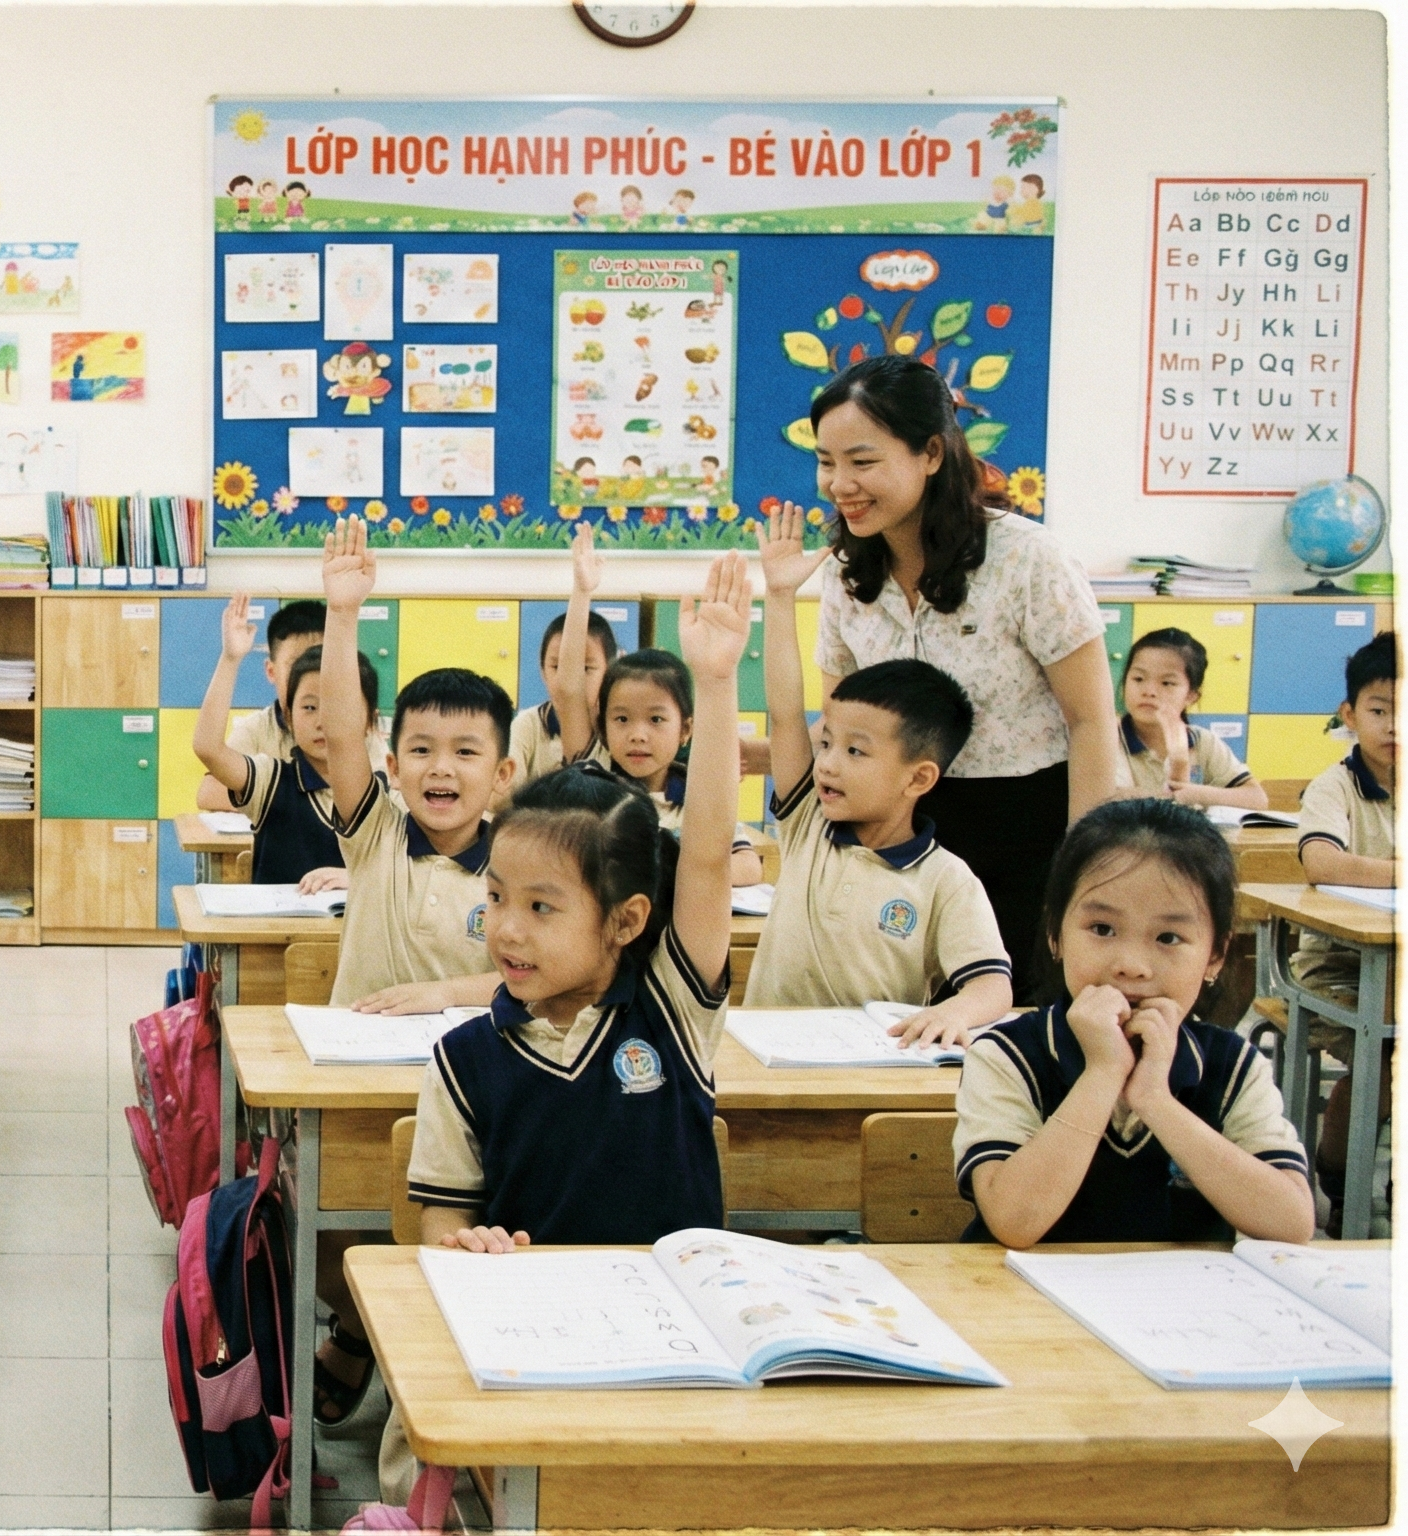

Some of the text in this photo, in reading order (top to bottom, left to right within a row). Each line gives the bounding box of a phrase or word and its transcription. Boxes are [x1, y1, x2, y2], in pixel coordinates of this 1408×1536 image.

[286, 126, 358, 175] LỚP
[372, 136, 449, 184] HỌC
[463, 136, 570, 184] HẠNH
[584, 127, 688, 176] PHÚC
[730, 129, 776, 176] BÉ
[791, 128, 866, 177] VÀO
[880, 127, 951, 177] LỚP
[966, 140, 982, 177] 1
